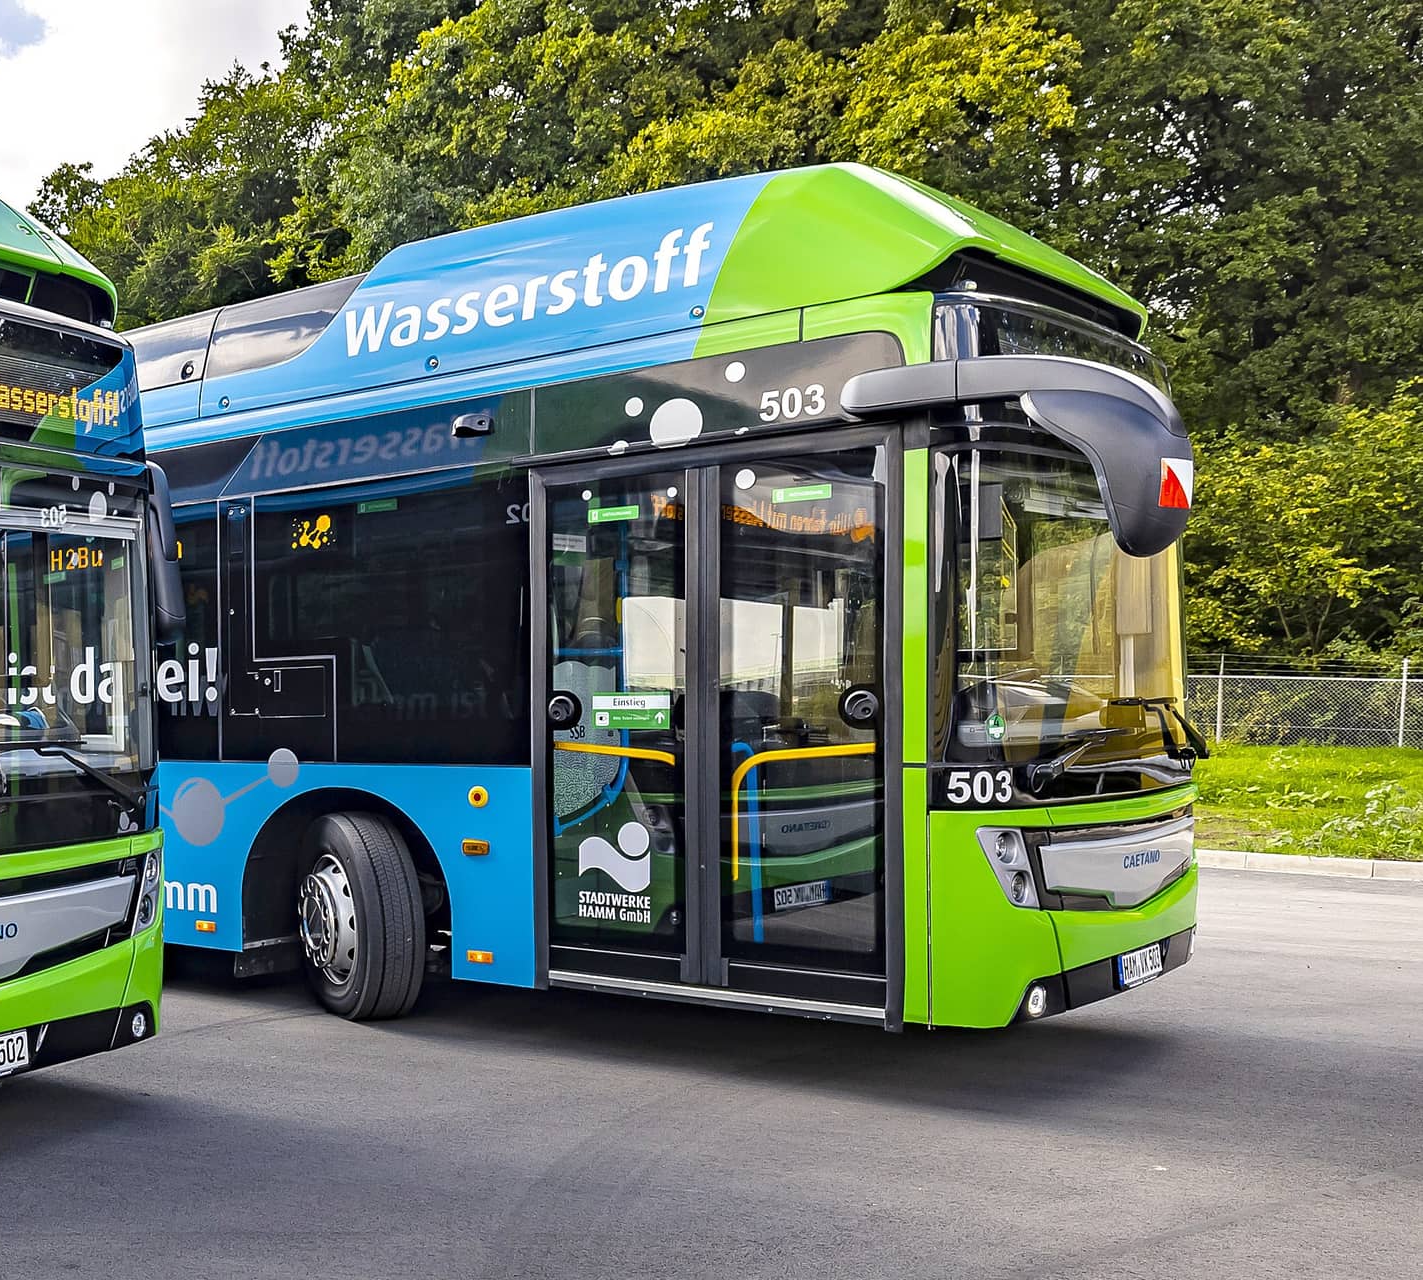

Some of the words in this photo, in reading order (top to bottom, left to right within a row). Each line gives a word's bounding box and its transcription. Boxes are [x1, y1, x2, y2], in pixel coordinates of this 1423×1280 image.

[345, 221, 715, 358] Wasserstoff
[759, 383, 826, 422] 503
[50, 547, 103, 572] H2Bu
[946, 770, 1013, 804] 503
[1123, 849, 1160, 869] CAETANO
[578, 890, 651, 909] STADTWERKE
[578, 904, 616, 920] HAMM
[619, 908, 651, 924] GmbH
